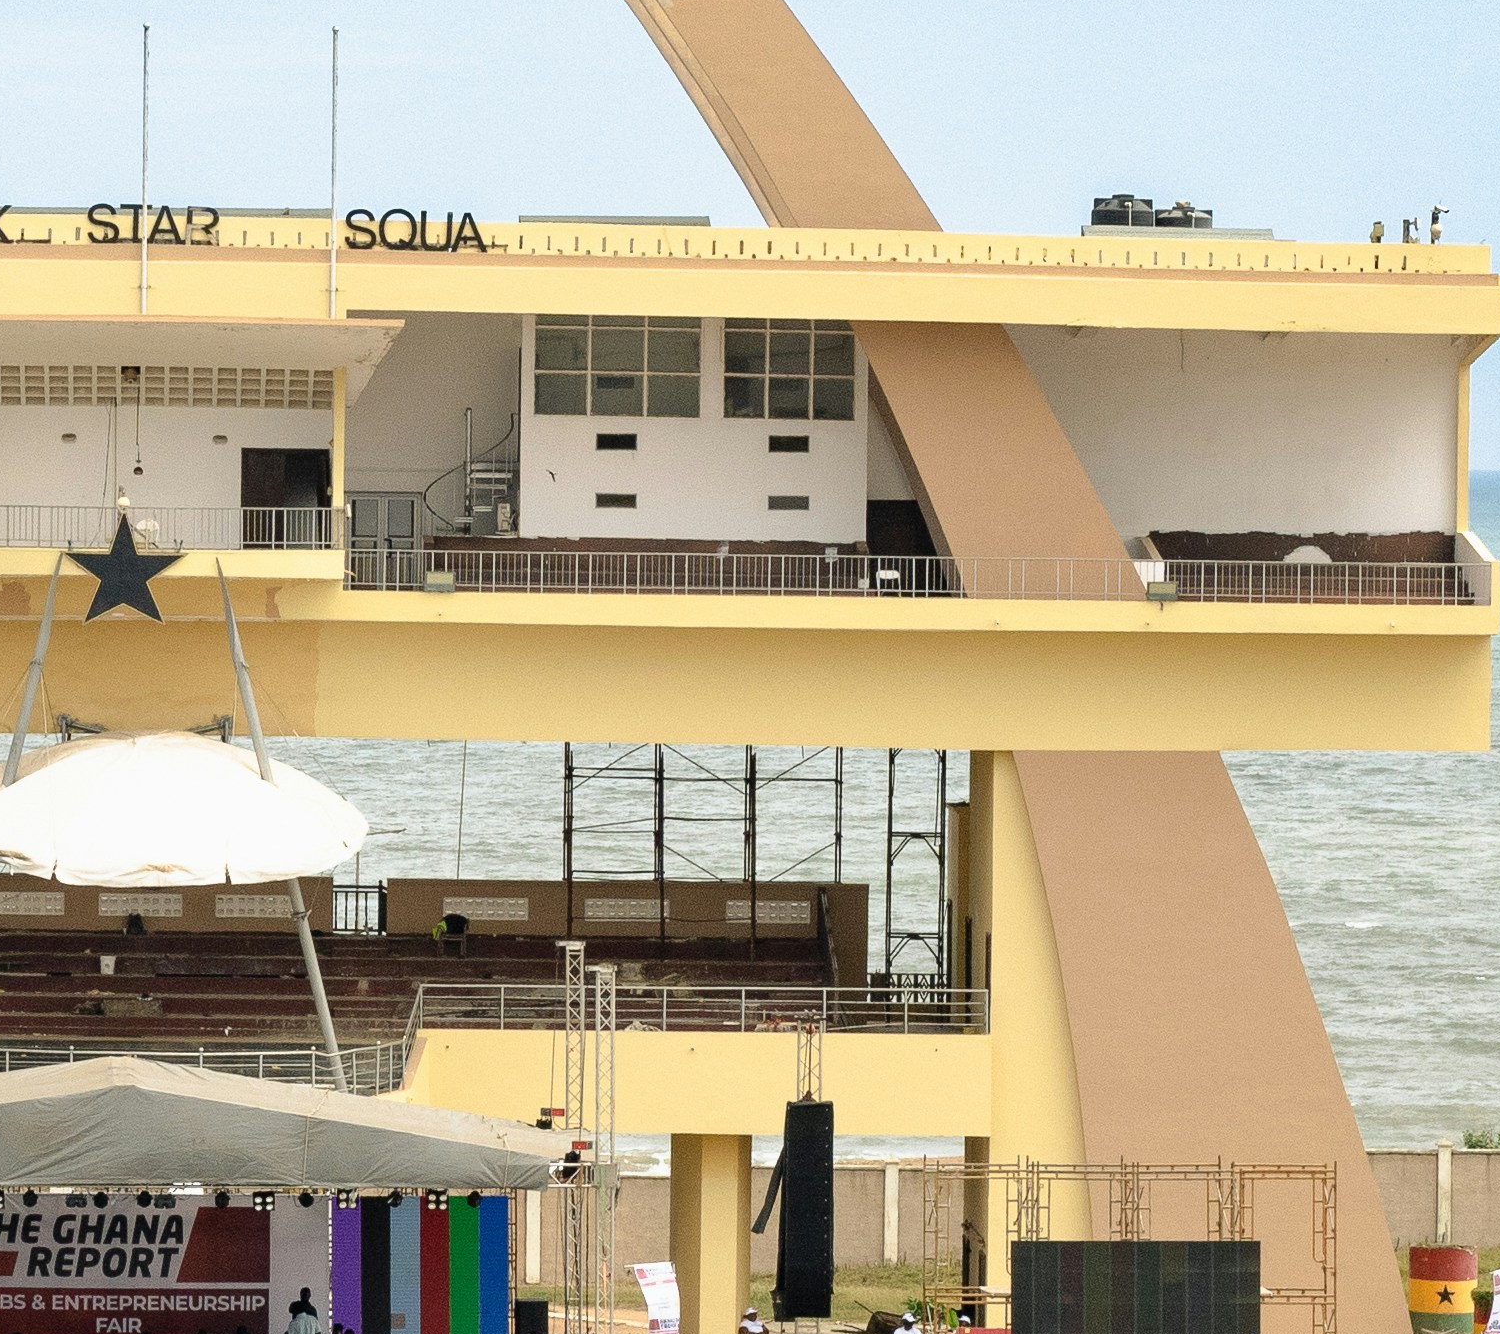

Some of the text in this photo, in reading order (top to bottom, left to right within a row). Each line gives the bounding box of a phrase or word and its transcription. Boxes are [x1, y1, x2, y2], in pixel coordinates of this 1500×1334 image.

[87, 203, 220, 246] STAR
[344, 208, 487, 253] SQUA
[52, 1213, 184, 1245] GHANA
[26, 1246, 180, 1278] REPORT
[32, 1294, 46, 1311] &
[51, 1294, 266, 1312] ENTREPRENEURSHIP
[95, 1317, 142, 1334] FAIR
